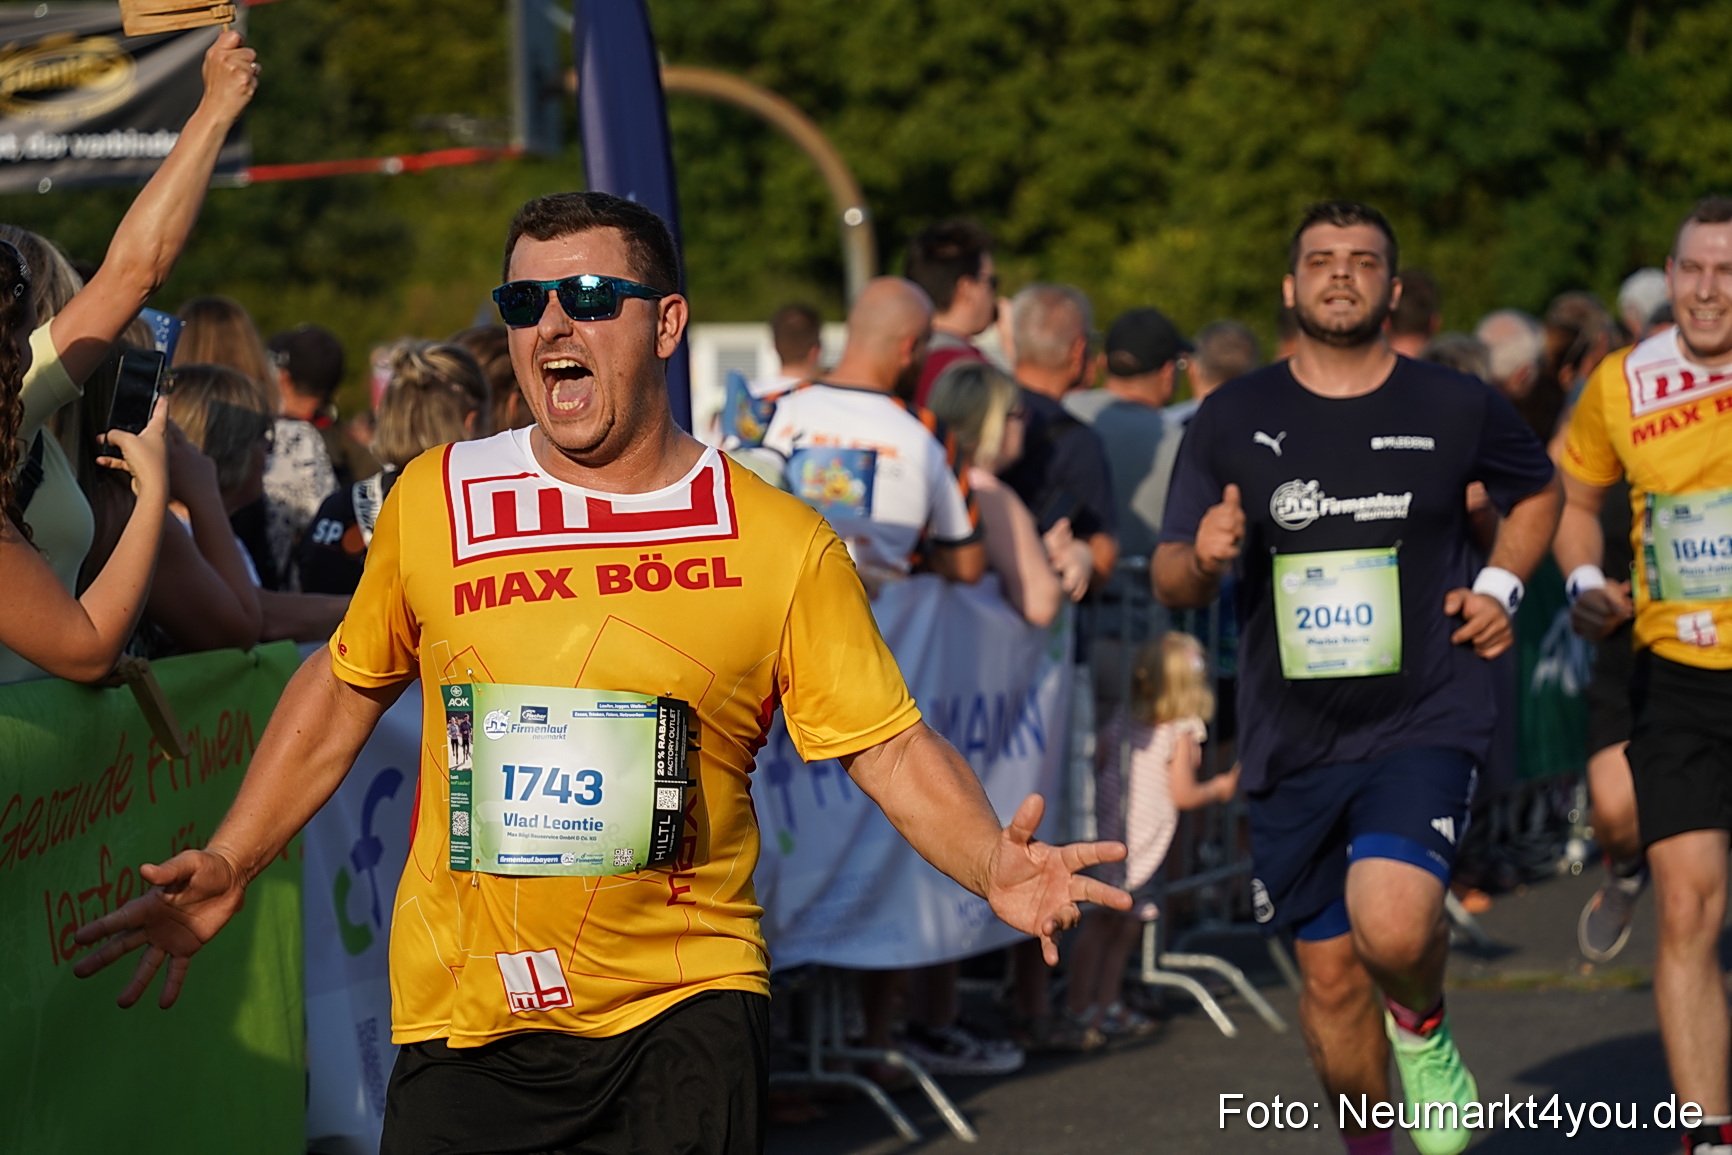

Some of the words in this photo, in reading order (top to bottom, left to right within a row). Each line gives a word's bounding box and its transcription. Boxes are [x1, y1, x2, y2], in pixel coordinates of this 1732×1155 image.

[1632, 405, 1701, 447] MAX
[454, 567, 578, 617] MAX
[595, 552, 743, 596] BÖGL
[1295, 603, 1374, 630] 2040
[447, 697, 470, 707] AOK
[510, 723, 568, 734] Firmenlauf
[658, 706, 668, 749] RABATT
[668, 708, 676, 738] OUTLET
[657, 760, 665, 776] 20
[658, 750, 666, 759] %
[666, 739, 675, 776] FACTORY
[501, 764, 604, 806] 1743
[503, 812, 539, 828] Vlad
[543, 814, 604, 832] Leontie
[655, 815, 670, 861] HILTL
[499, 856, 559, 864] firmenlauf.bayern
